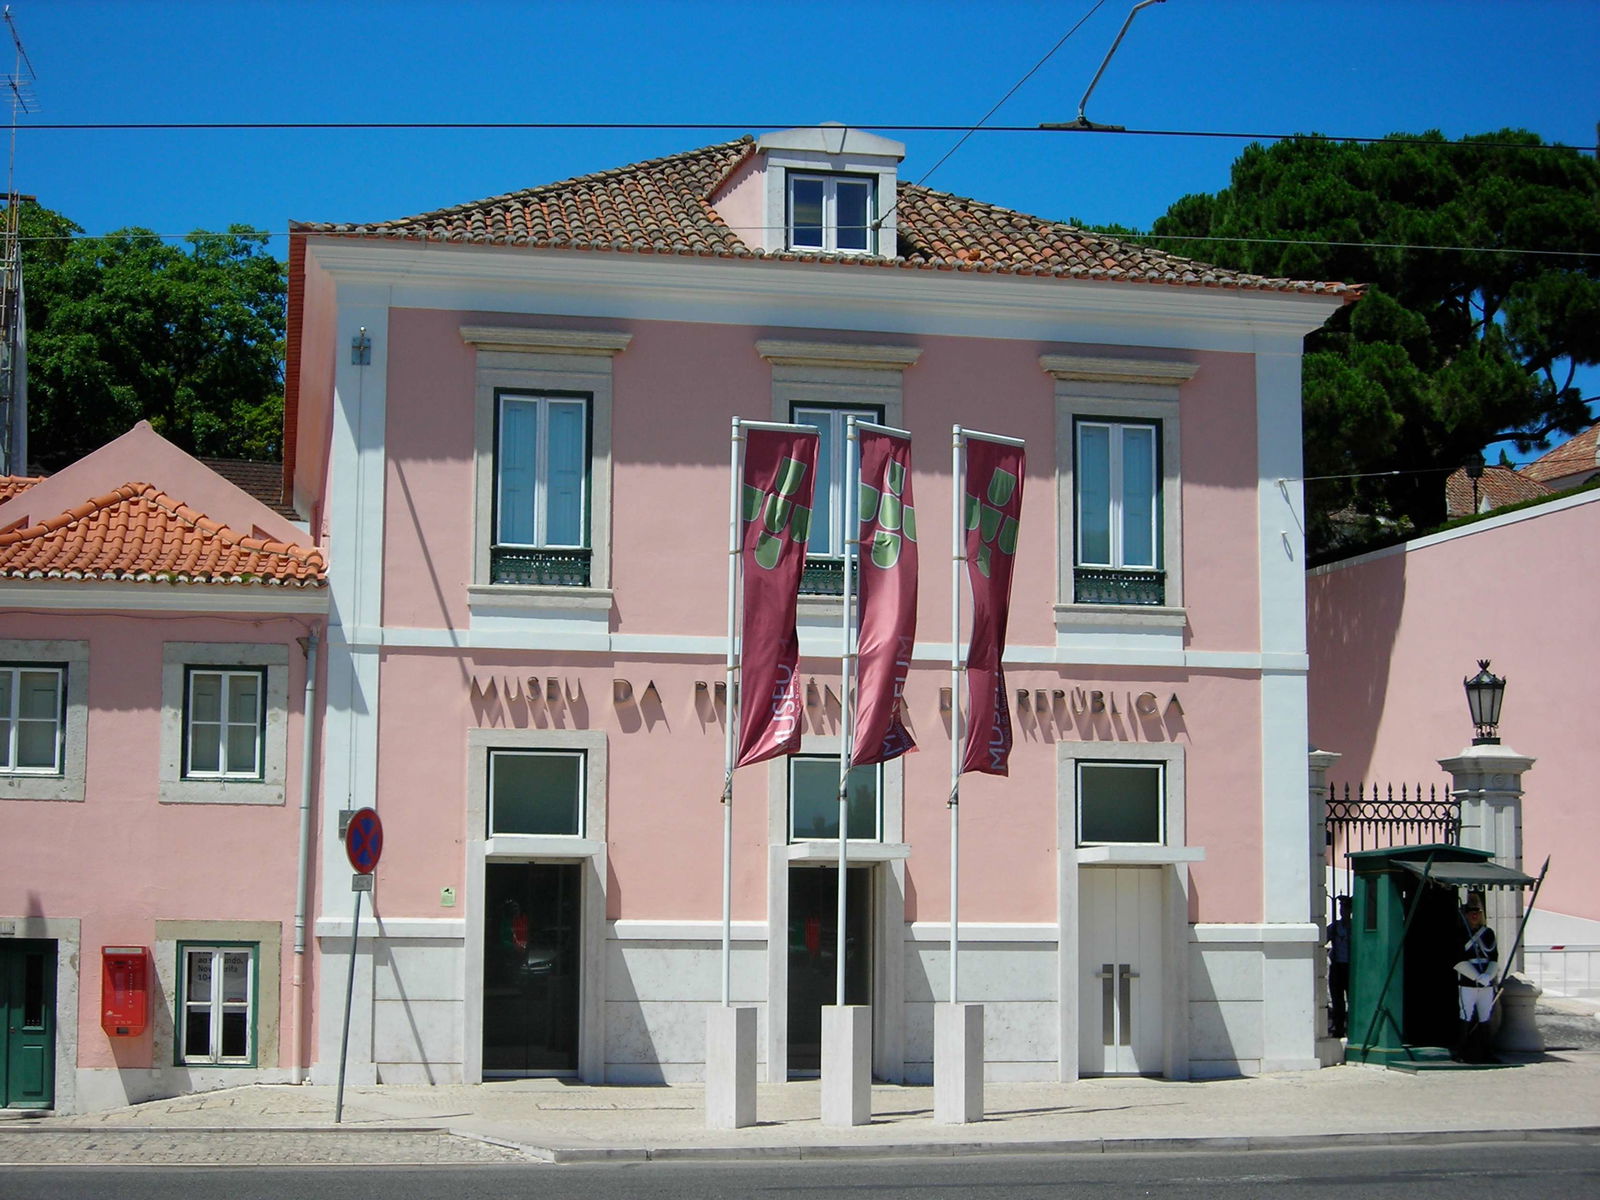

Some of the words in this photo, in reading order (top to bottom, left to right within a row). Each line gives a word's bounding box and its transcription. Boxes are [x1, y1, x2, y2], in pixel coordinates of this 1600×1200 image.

[470, 674, 583, 704] MUSEU
[612, 677, 665, 706] DA
[1015, 685, 1187, 717] REPÚBLICA
